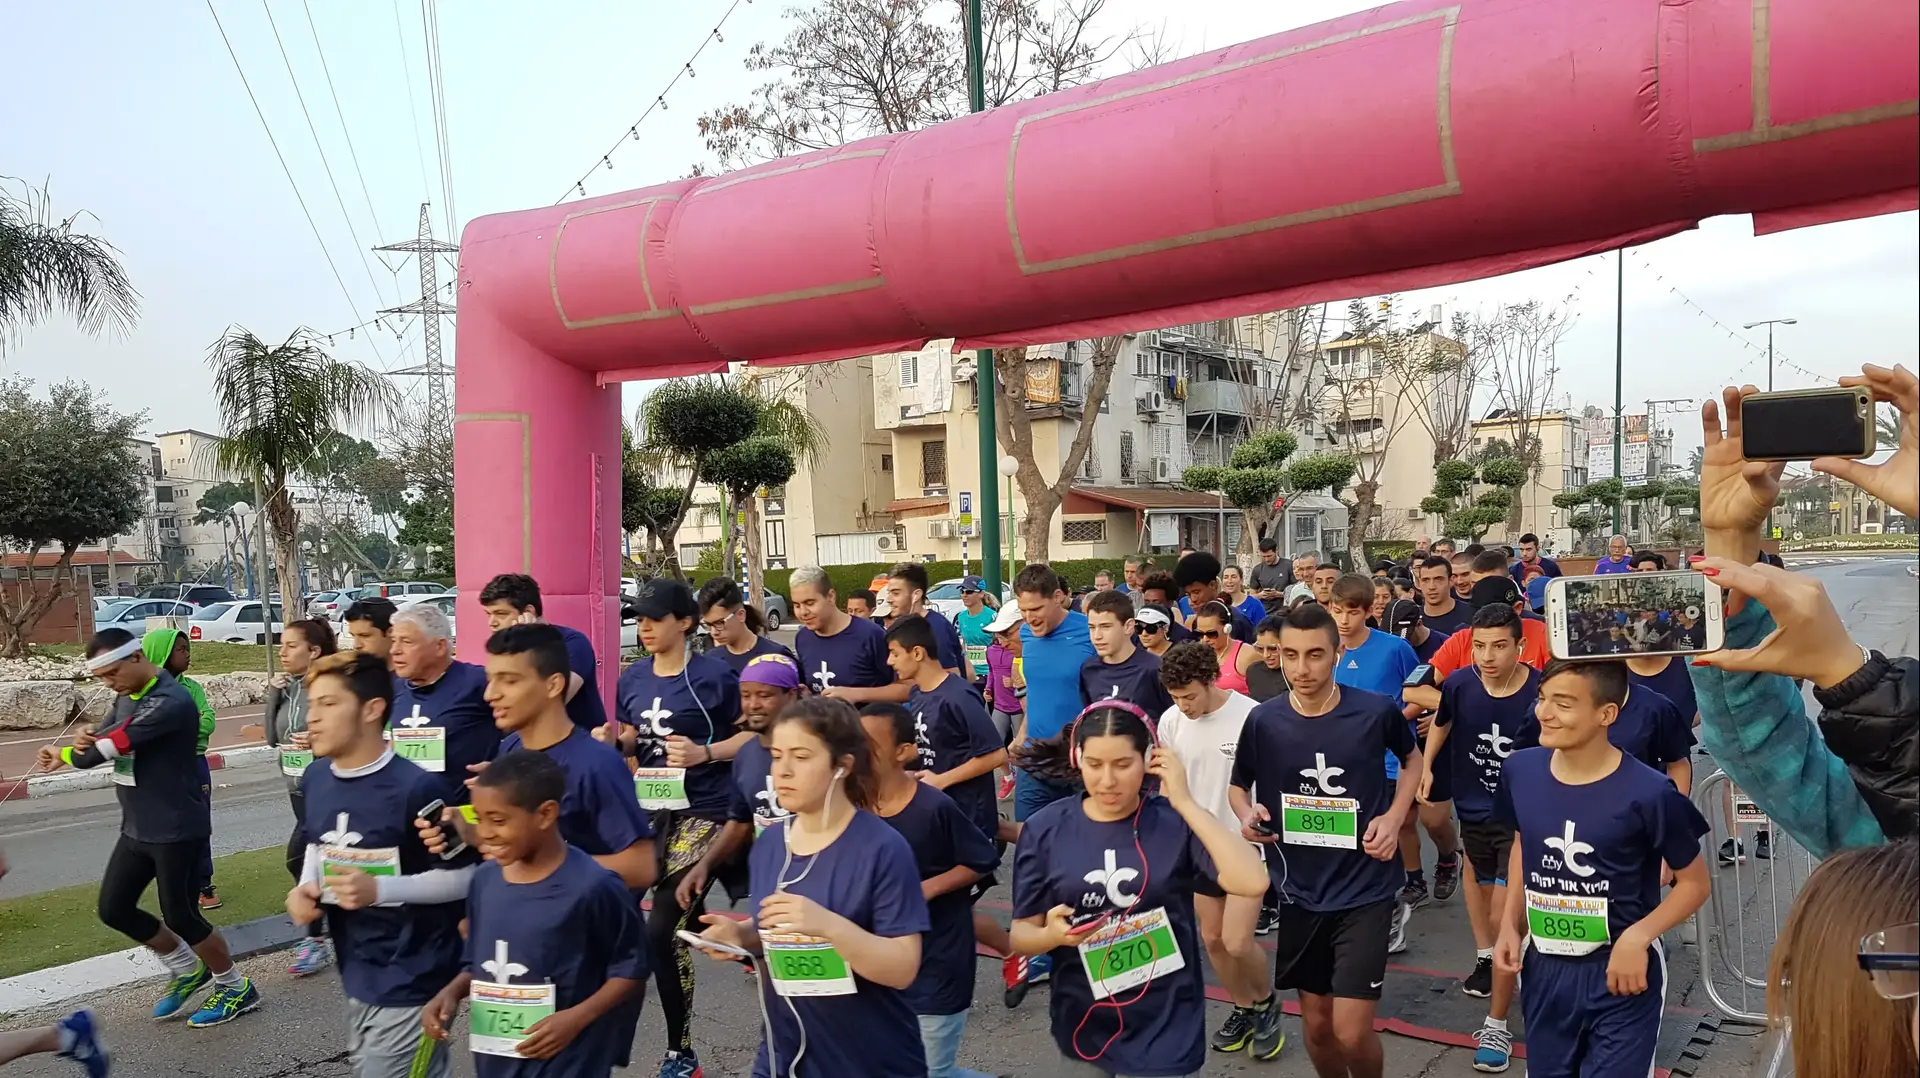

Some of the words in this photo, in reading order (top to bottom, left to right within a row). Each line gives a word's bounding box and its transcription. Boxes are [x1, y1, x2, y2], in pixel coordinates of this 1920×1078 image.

[970, 652, 981, 660] 777
[404, 743, 428, 759] 771
[284, 755, 302, 767] 745
[646, 783, 672, 798] 766
[1301, 813, 1335, 832] 891
[1557, 878, 1579, 893] אור
[1580, 879, 1610, 895] מרוץ
[1543, 916, 1586, 939] 895
[1109, 939, 1154, 972] 870
[783, 955, 827, 977] 868
[486, 1009, 526, 1034] 754
